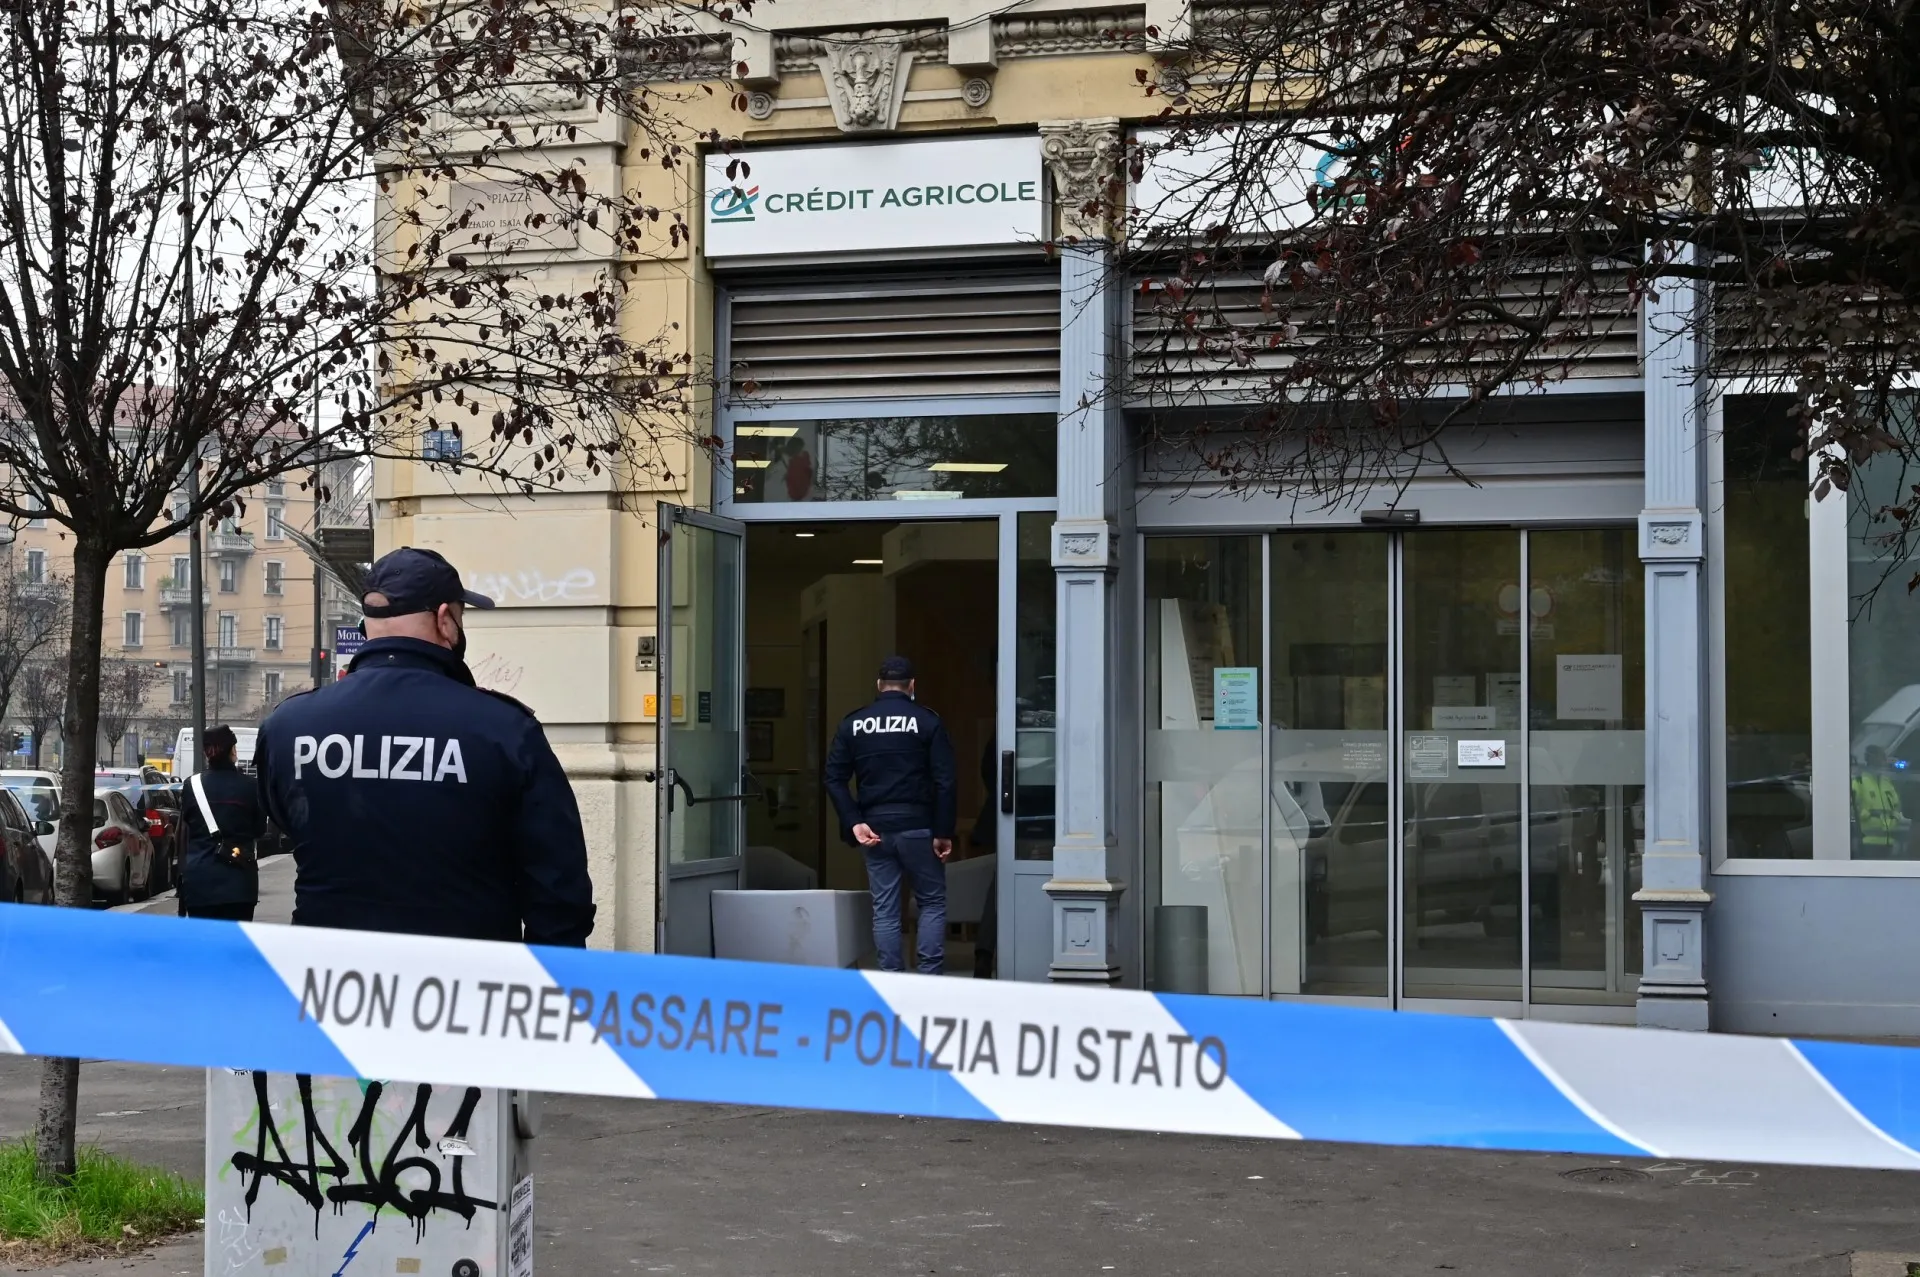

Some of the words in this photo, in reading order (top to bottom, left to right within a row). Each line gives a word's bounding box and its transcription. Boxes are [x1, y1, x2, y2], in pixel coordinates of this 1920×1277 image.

[492, 193, 532, 204] PIAZZA
[764, 187, 874, 214] CRÉDIT
[880, 181, 1036, 208] AGRICOLE
[853, 716, 918, 736] POLIZIA
[294, 733, 468, 784] POLIZIA
[298, 967, 399, 1029] NON
[412, 976, 784, 1058] OLTREPASSARE
[824, 1008, 1000, 1074] POLIZIA
[1016, 1023, 1060, 1079] DI
[1074, 1027, 1228, 1091] STATO
